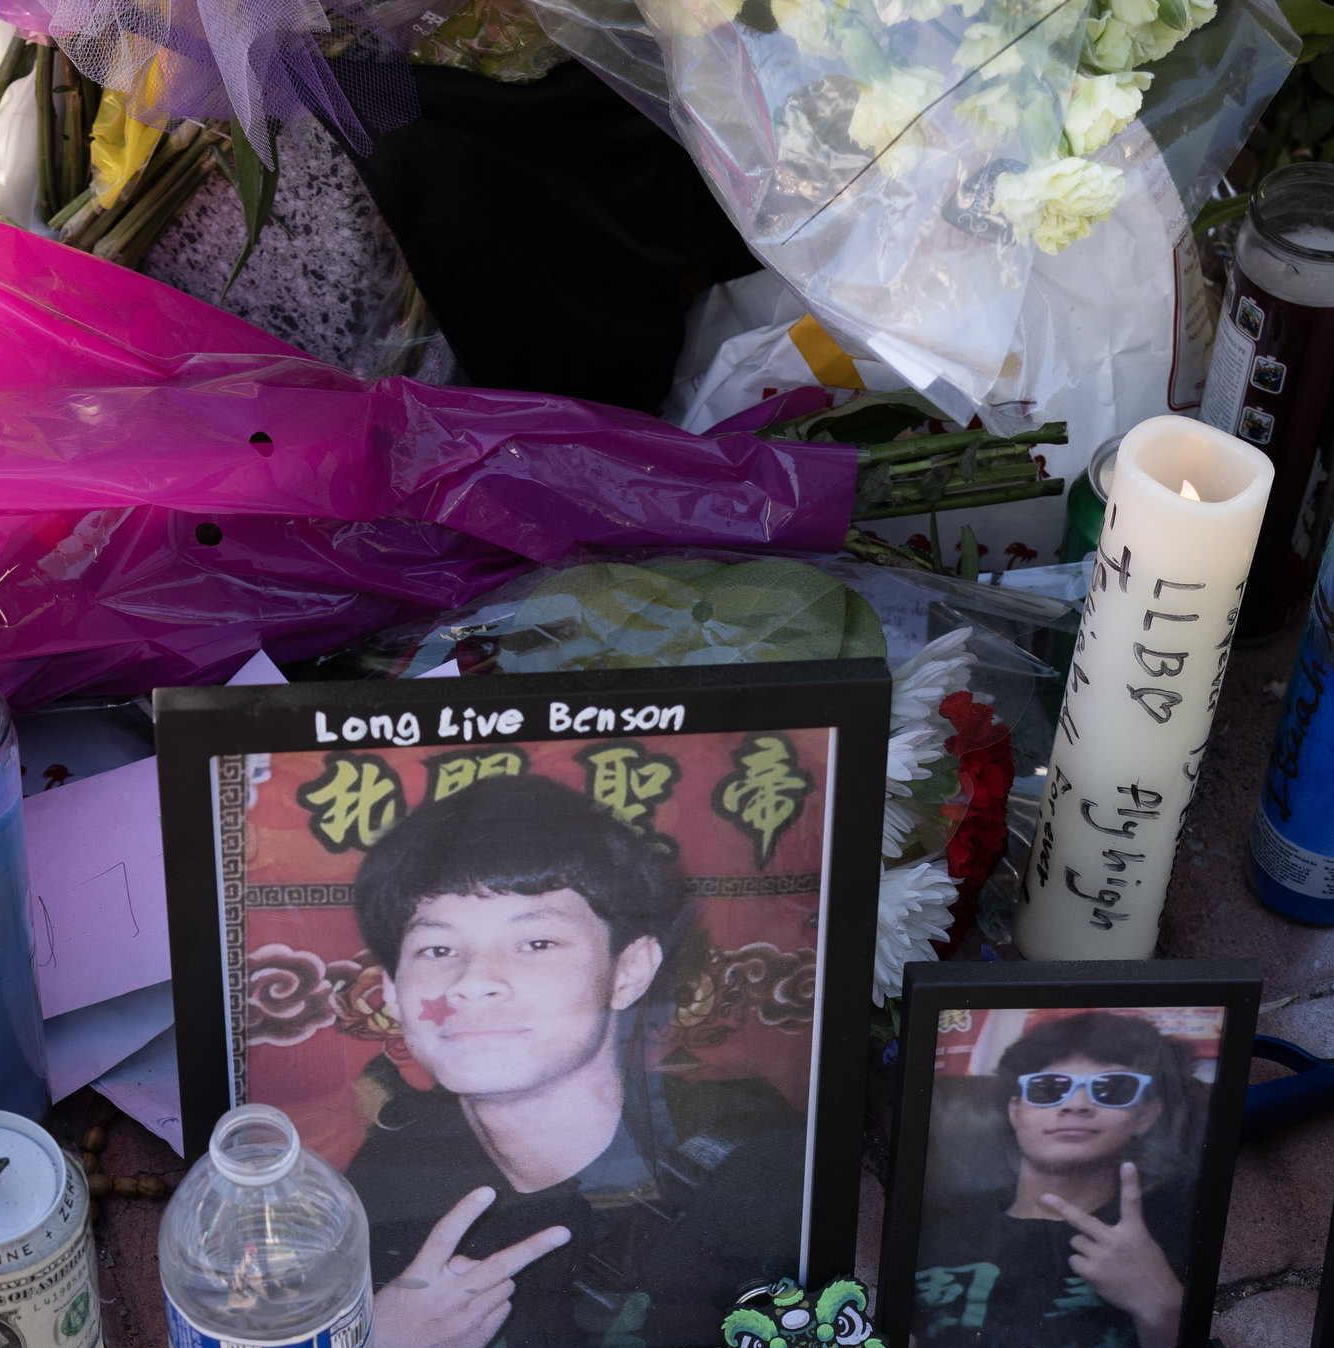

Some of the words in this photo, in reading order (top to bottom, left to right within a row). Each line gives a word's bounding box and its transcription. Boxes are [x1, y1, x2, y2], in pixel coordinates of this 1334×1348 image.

[1132, 577, 1208, 678] LLB
[314, 709, 421, 746] Long
[437, 707, 525, 741] Live
[549, 702, 686, 735] Benson
[1064, 846, 1148, 932] high
